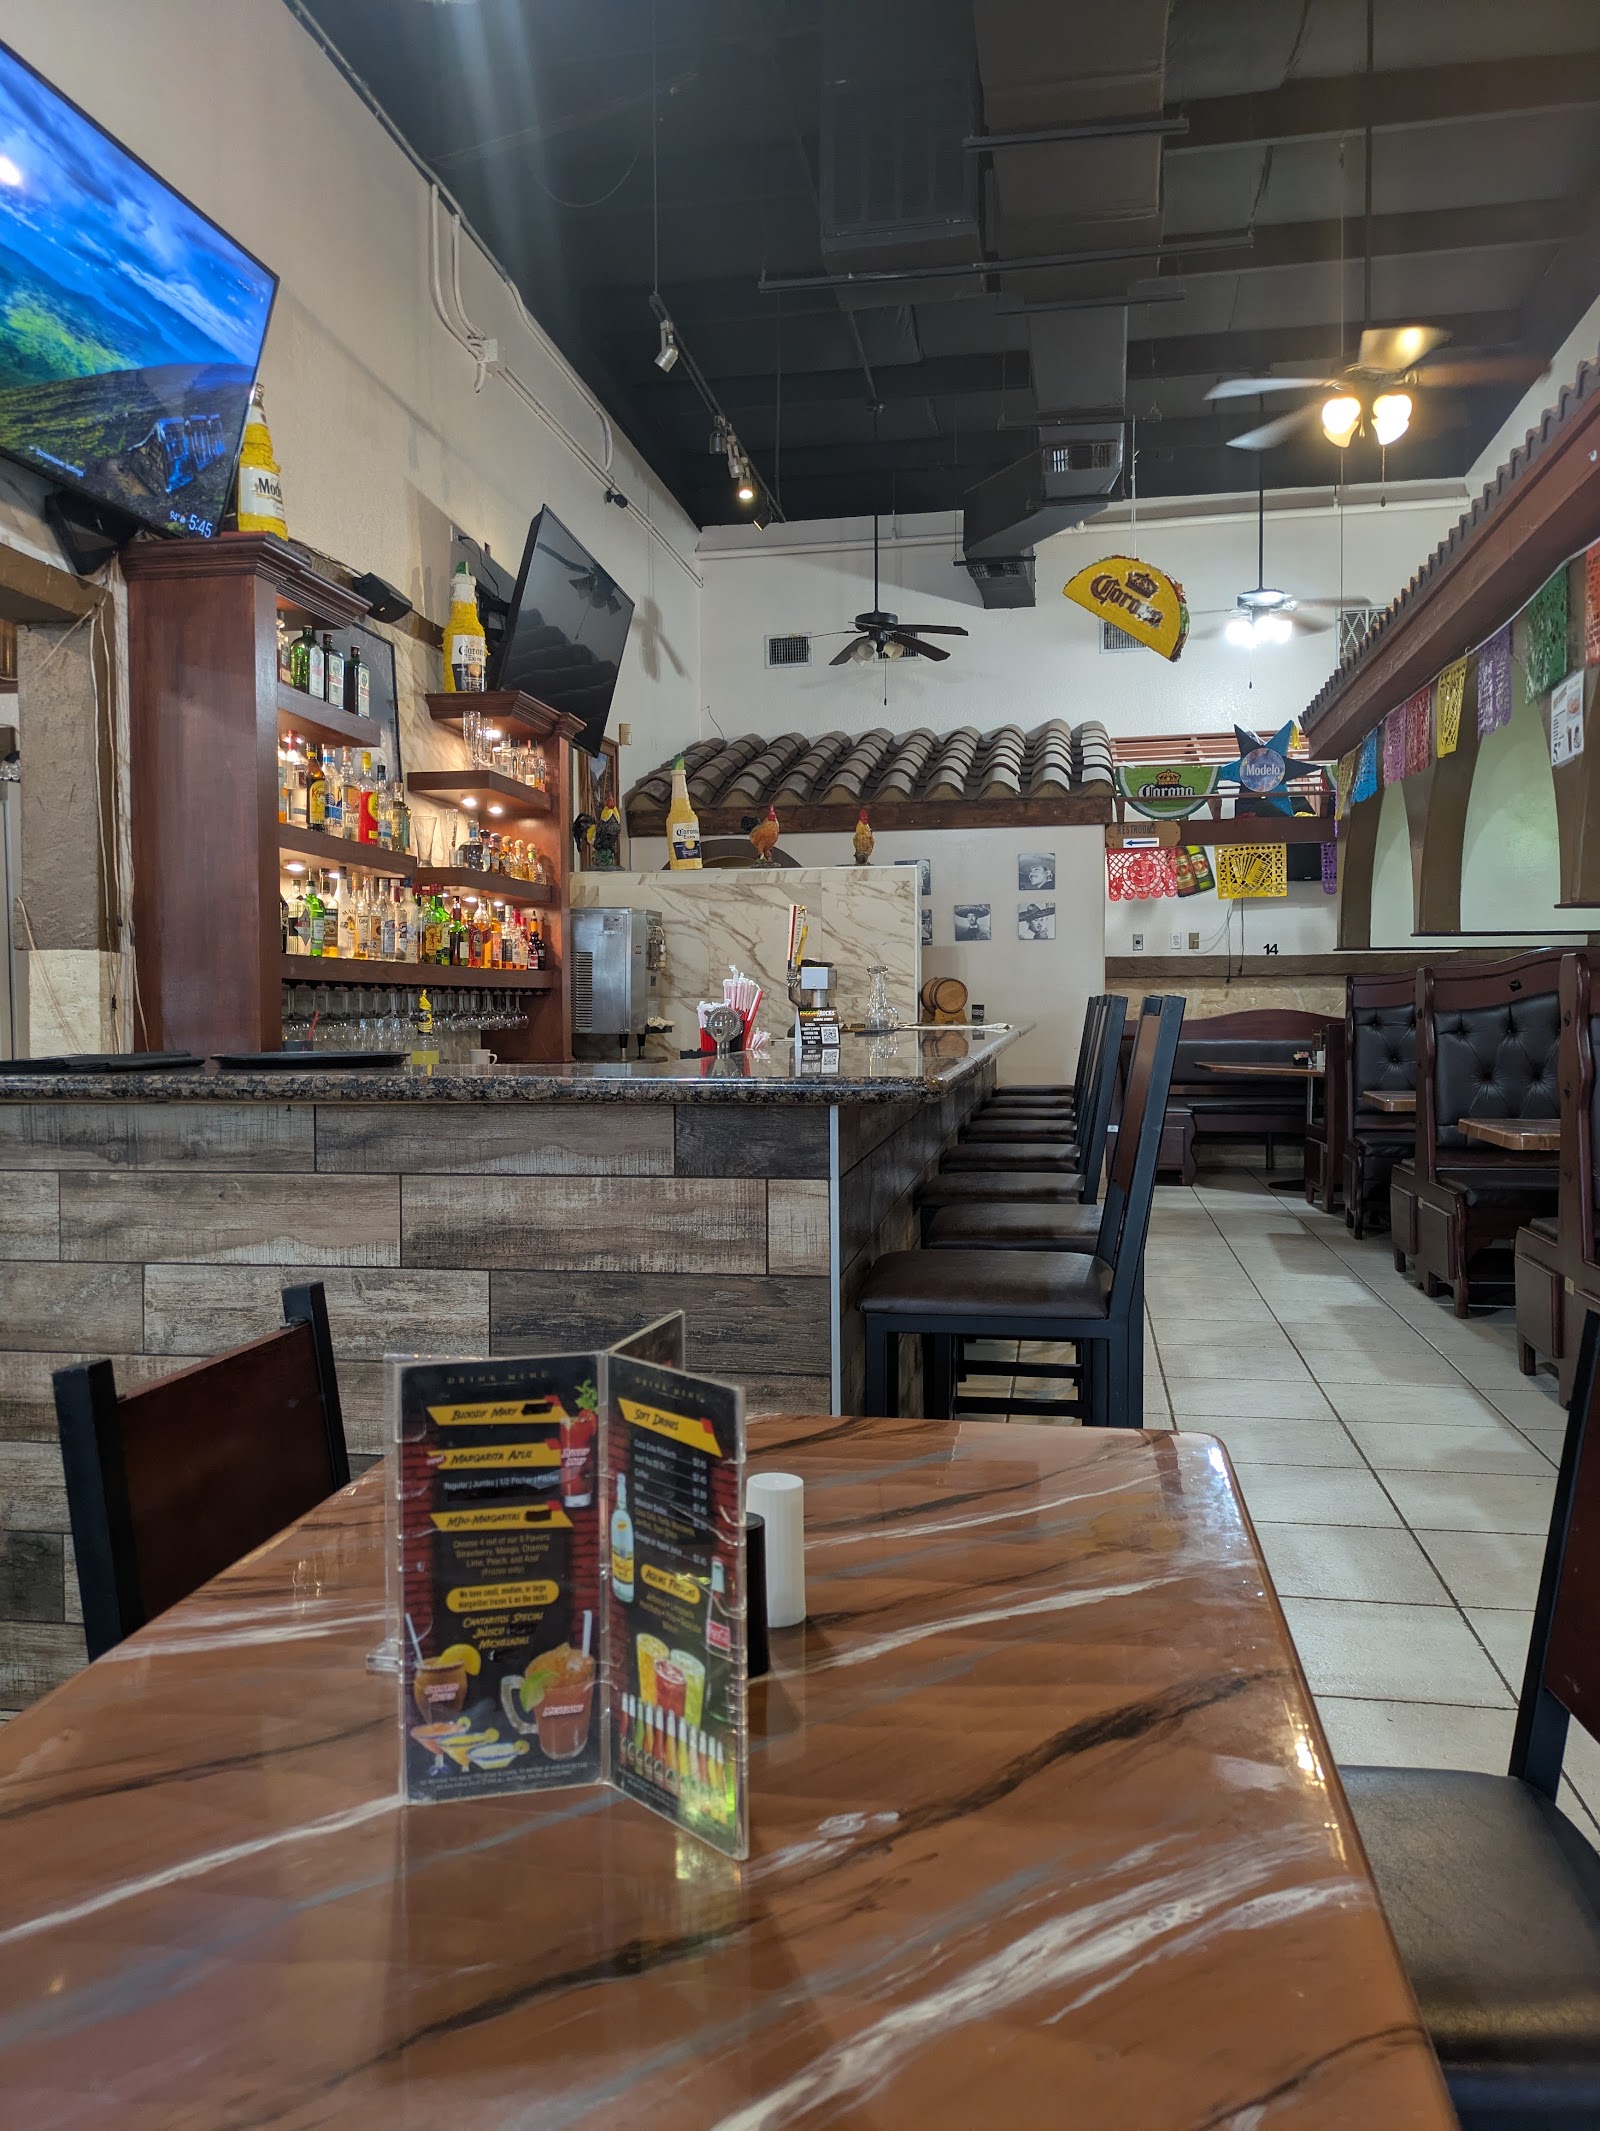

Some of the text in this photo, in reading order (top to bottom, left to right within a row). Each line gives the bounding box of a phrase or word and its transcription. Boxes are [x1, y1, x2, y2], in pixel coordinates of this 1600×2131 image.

[188, 514, 212, 538] 5:45
[1246, 764, 1280, 777] Modelo
[1137, 783, 1196, 803] Corona
[676, 828, 699, 838] Corona
[1117, 823, 1157, 835] RESTROOMS
[1263, 943, 1279, 955] 14
[447, 1374, 496, 1385] DRINK
[451, 1407, 518, 1422] BLOODY MARY
[634, 1409, 680, 1431] SOFT DRINKS
[451, 1450, 533, 1465] MARGARITA AZUL
[444, 1474, 559, 1491] Regular Jumbo 1/2 Pitcher Pitcher
[453, 1540, 478, 1549] Choose
